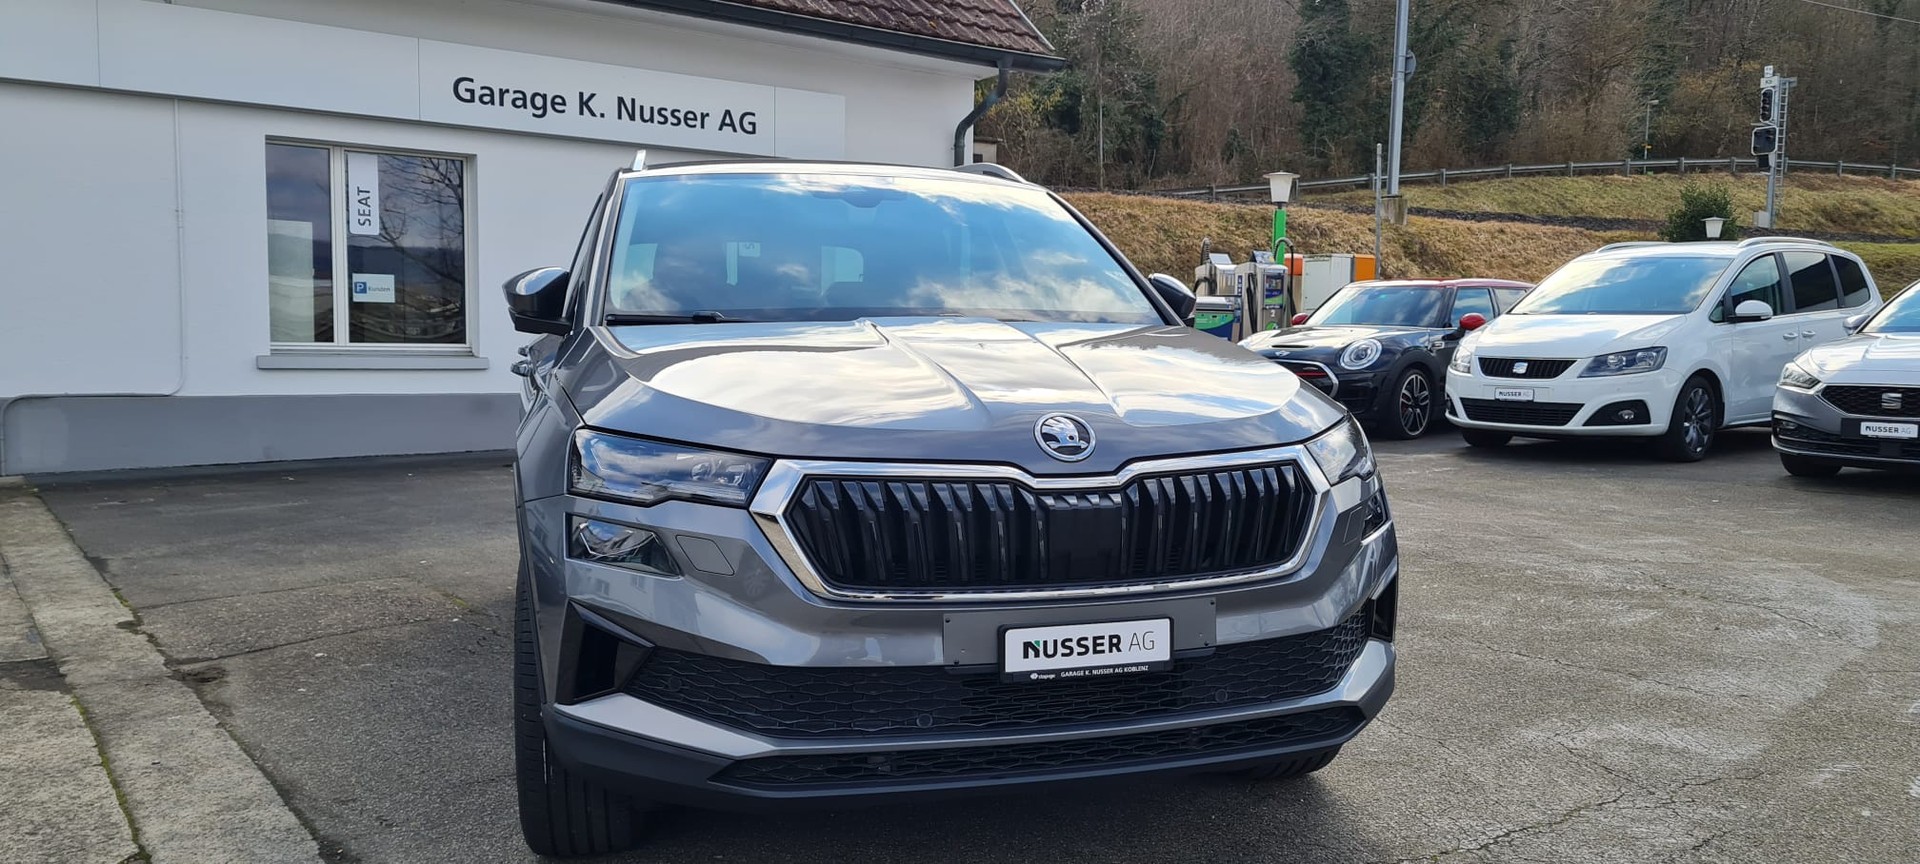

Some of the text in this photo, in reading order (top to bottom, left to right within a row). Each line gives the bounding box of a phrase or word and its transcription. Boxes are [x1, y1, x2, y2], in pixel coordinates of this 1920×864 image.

[452, 77, 758, 135] Garage K. Nusser AG
[357, 186, 371, 227] SEAT
[368, 285, 391, 293] Kunden
[1865, 425, 1899, 433] NUSSER
[1022, 631, 1155, 659] NUSSER AG
[1060, 670, 1084, 678] GARAGE
[1124, 665, 1149, 673] KOBLENZ
